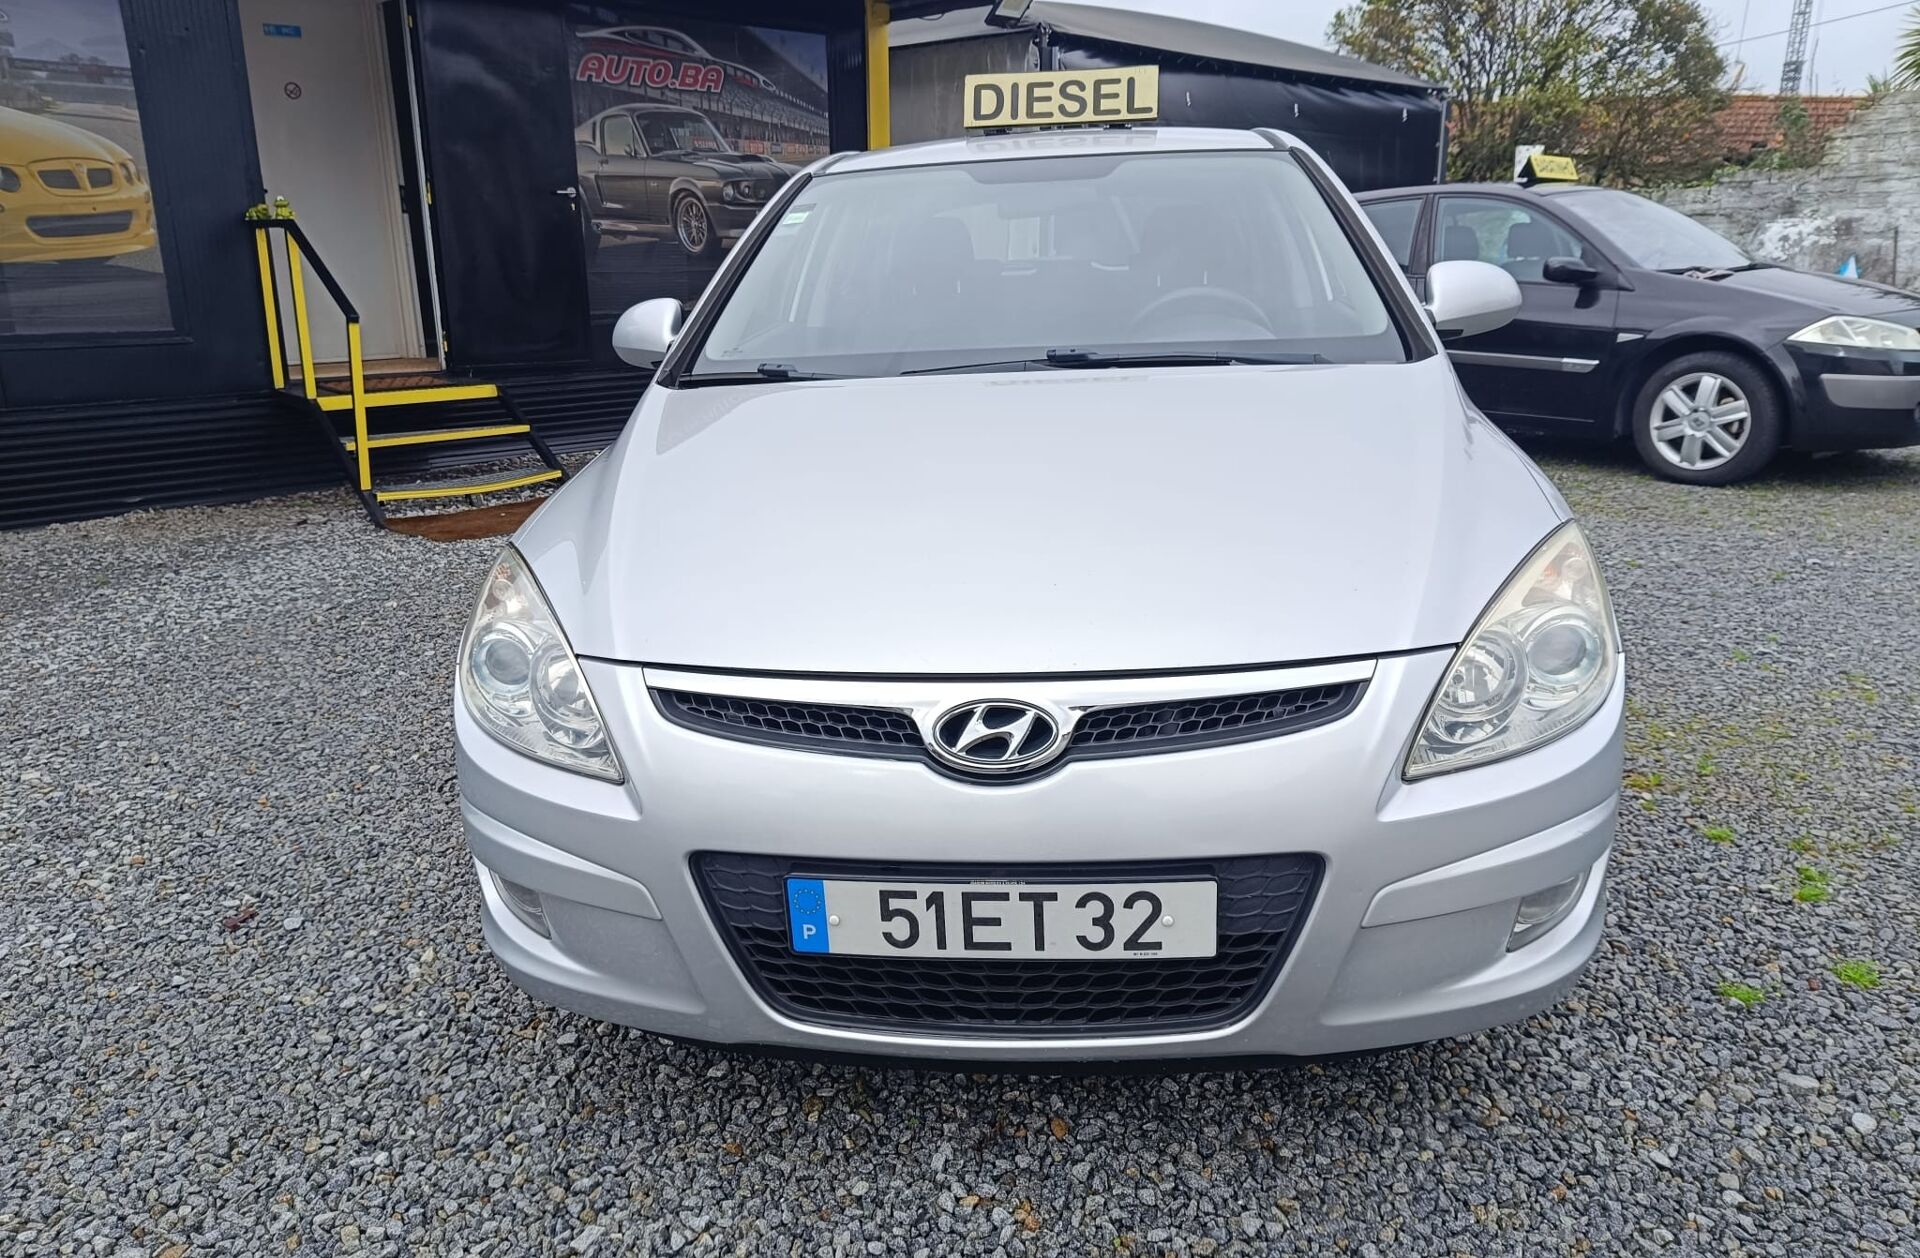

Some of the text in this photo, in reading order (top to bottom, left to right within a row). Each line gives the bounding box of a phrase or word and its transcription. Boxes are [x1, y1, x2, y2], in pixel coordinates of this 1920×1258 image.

[576, 53, 724, 93] AUTO.BA
[973, 77, 1153, 121] DIESEL
[802, 924, 816, 940] P
